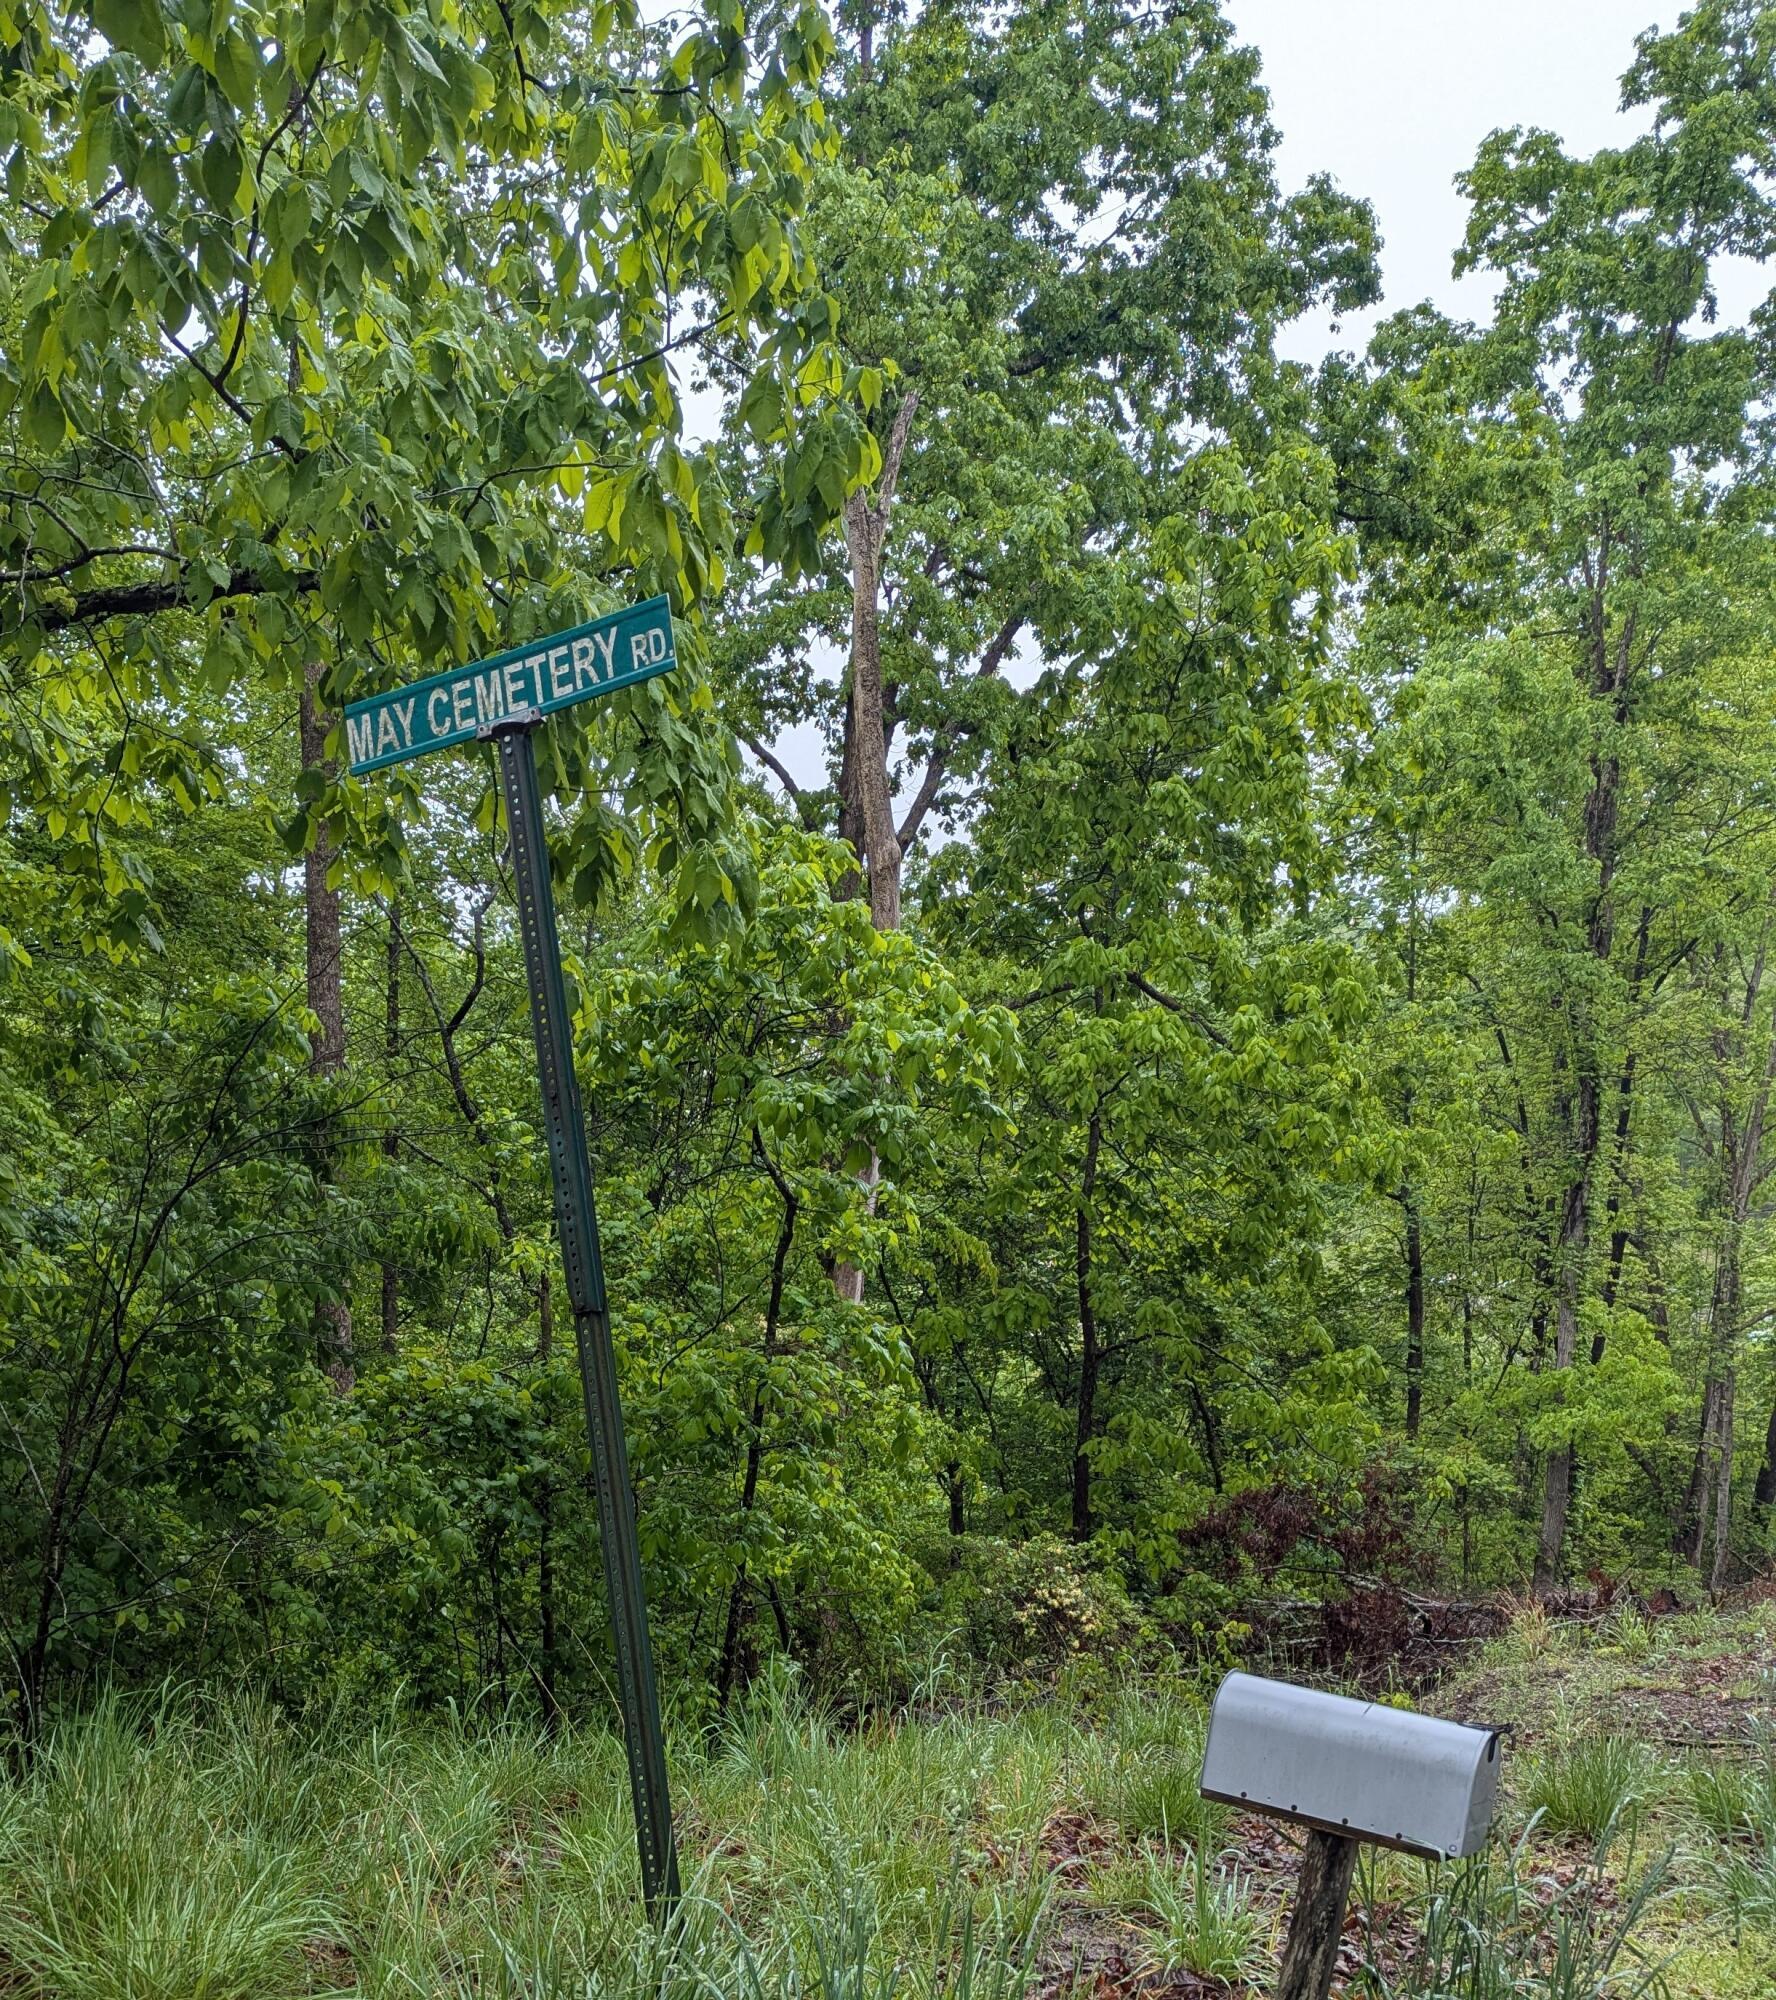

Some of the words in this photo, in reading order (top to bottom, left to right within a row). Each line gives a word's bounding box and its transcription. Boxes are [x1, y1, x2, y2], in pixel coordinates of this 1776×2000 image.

[346, 697, 415, 765] MAY
[428, 626, 618, 737] CEMETERY
[631, 627, 674, 670] RD.
